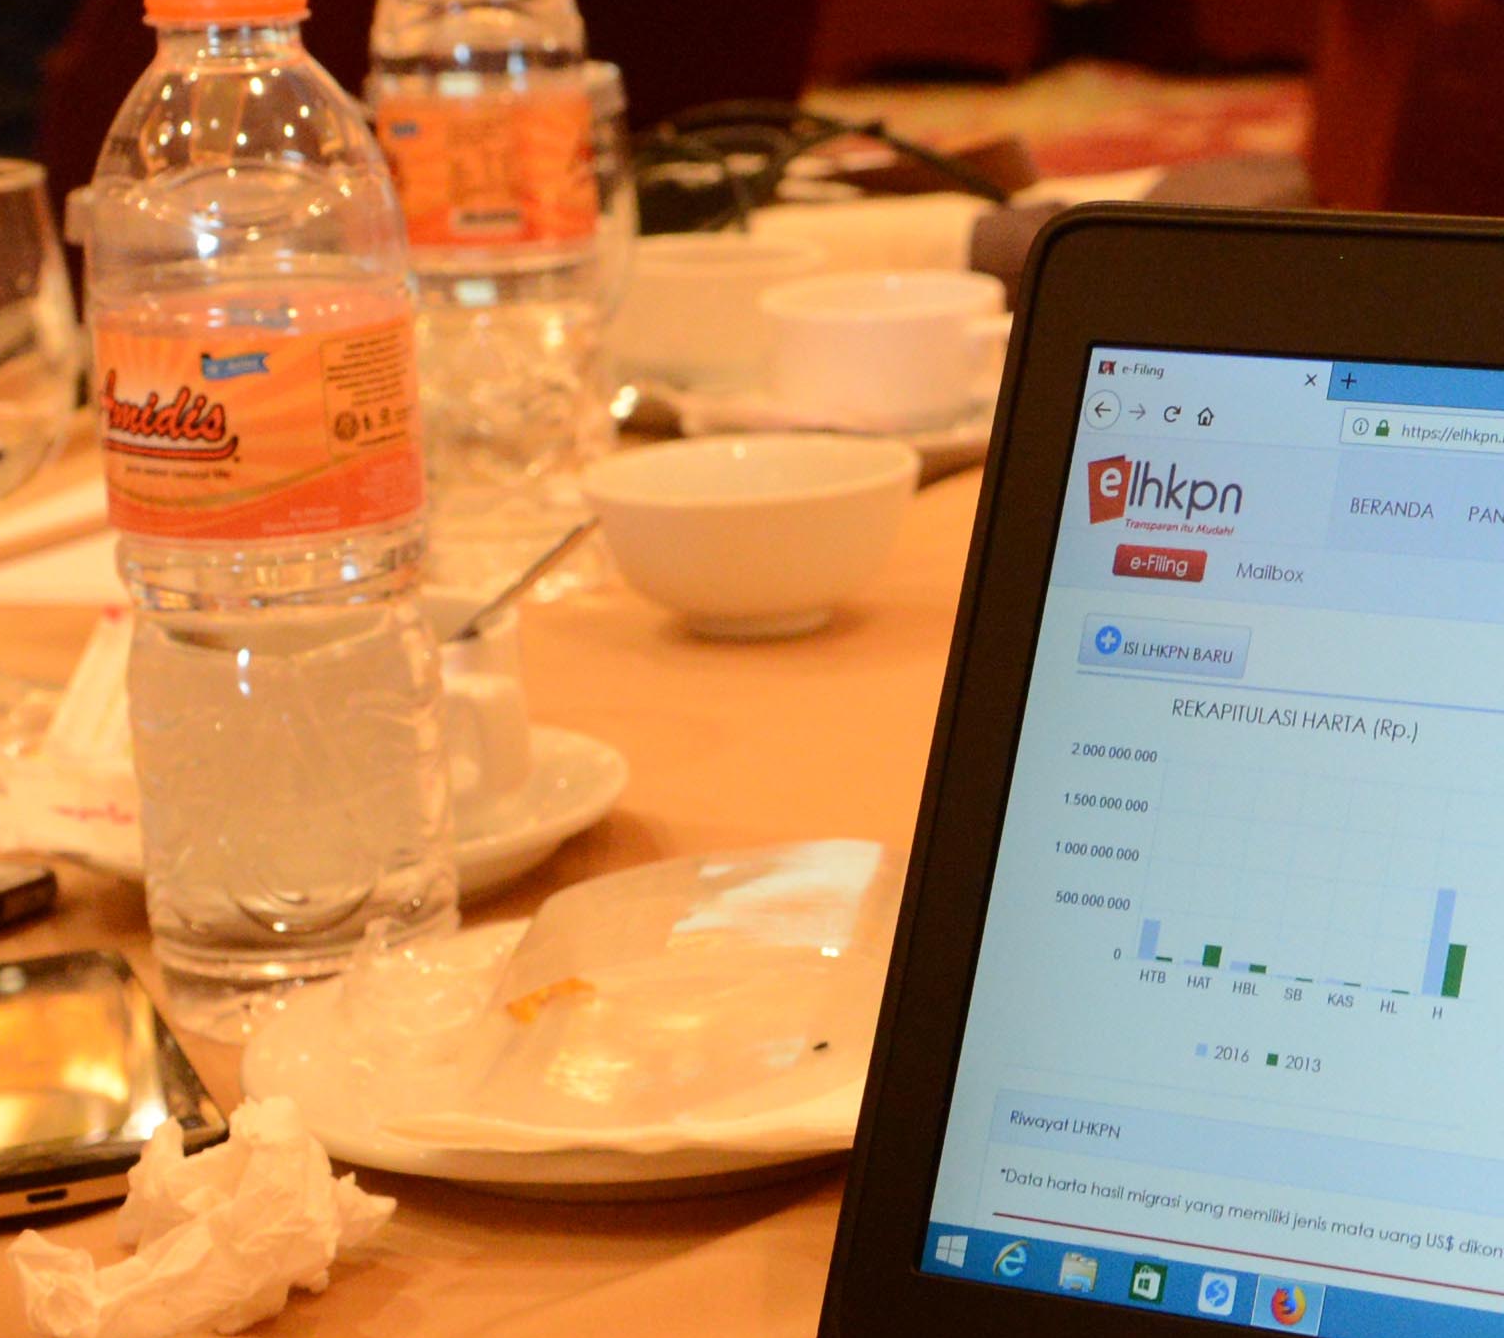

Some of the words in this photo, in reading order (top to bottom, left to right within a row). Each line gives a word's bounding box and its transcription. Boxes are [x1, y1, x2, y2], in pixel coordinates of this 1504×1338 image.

[1122, 362, 1164, 379] e-Filing
[1099, 460, 1243, 518] elhkpn
[1350, 497, 1435, 520] BERANDA
[1125, 518, 1178, 534] Transparan
[1130, 555, 1189, 577] e-Filing
[1236, 563, 1304, 583] Mailbox
[1123, 640, 1139, 656] ISI
[1142, 643, 1190, 660] LHKPN
[1193, 647, 1234, 664] BARU
[1172, 698, 1296, 728] REKAPITULASI
[1302, 710, 1367, 735] HARTA
[1372, 717, 1419, 744] (Rp.)
[1139, 969, 1167, 984] HTB
[1187, 974, 1212, 990] HAT
[1232, 980, 1259, 996] HBL
[1284, 986, 1302, 1002] SB
[1327, 992, 1354, 1008] KAS
[1379, 999, 1397, 1014] HL
[1432, 1007, 1443, 1020] H
[1214, 1045, 1250, 1063] 2016
[1285, 1055, 1321, 1074] 2013
[1009, 1110, 1069, 1134] Riwayat
[1071, 1119, 1121, 1140] LHKPN
[1046, 1174, 1088, 1198] harta
[1090, 1181, 1124, 1202] hasil
[1127, 1187, 1182, 1213] migrasi
[1184, 1198, 1224, 1221] yang
[1228, 1202, 1289, 1227] memiliki
[1291, 1211, 1328, 1233] jenis
[1330, 1218, 1375, 1241] mata
[1378, 1227, 1421, 1251] uang
[1426, 1233, 1455, 1255] US$
